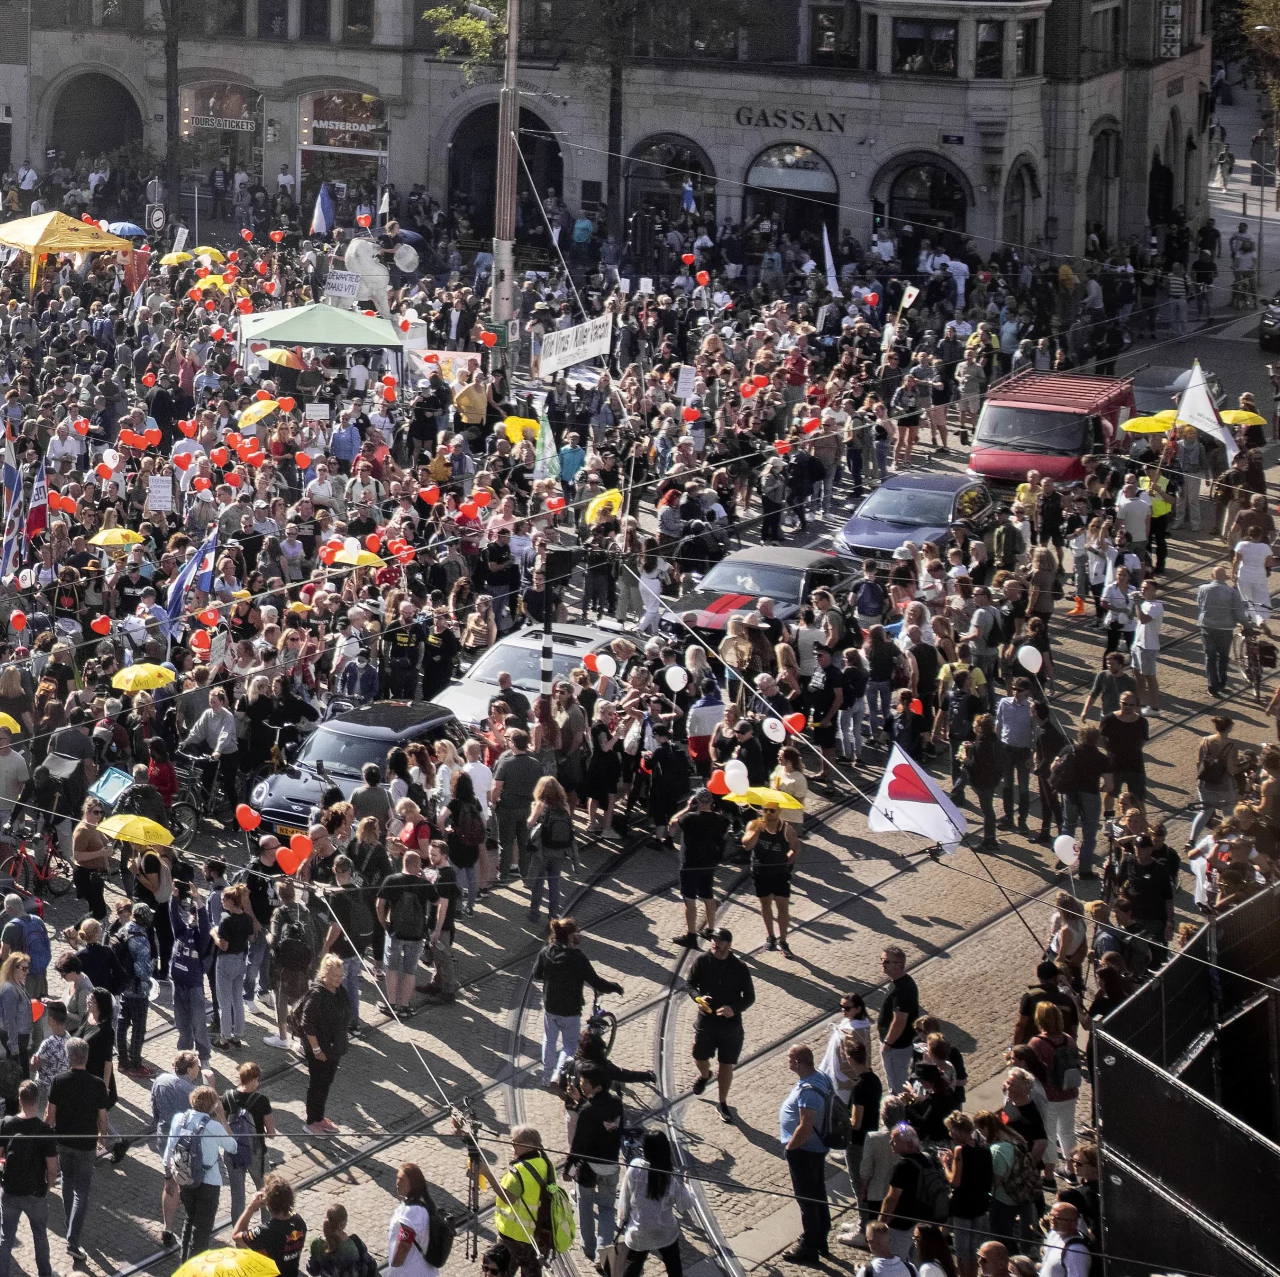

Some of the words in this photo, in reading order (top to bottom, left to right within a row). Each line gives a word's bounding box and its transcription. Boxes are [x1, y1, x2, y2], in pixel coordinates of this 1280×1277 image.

[190, 116, 215, 128] TOURS
[216, 118, 223, 129] &
[223, 119, 256, 131] TICKETS
[736, 106, 846, 133] GASSAN
